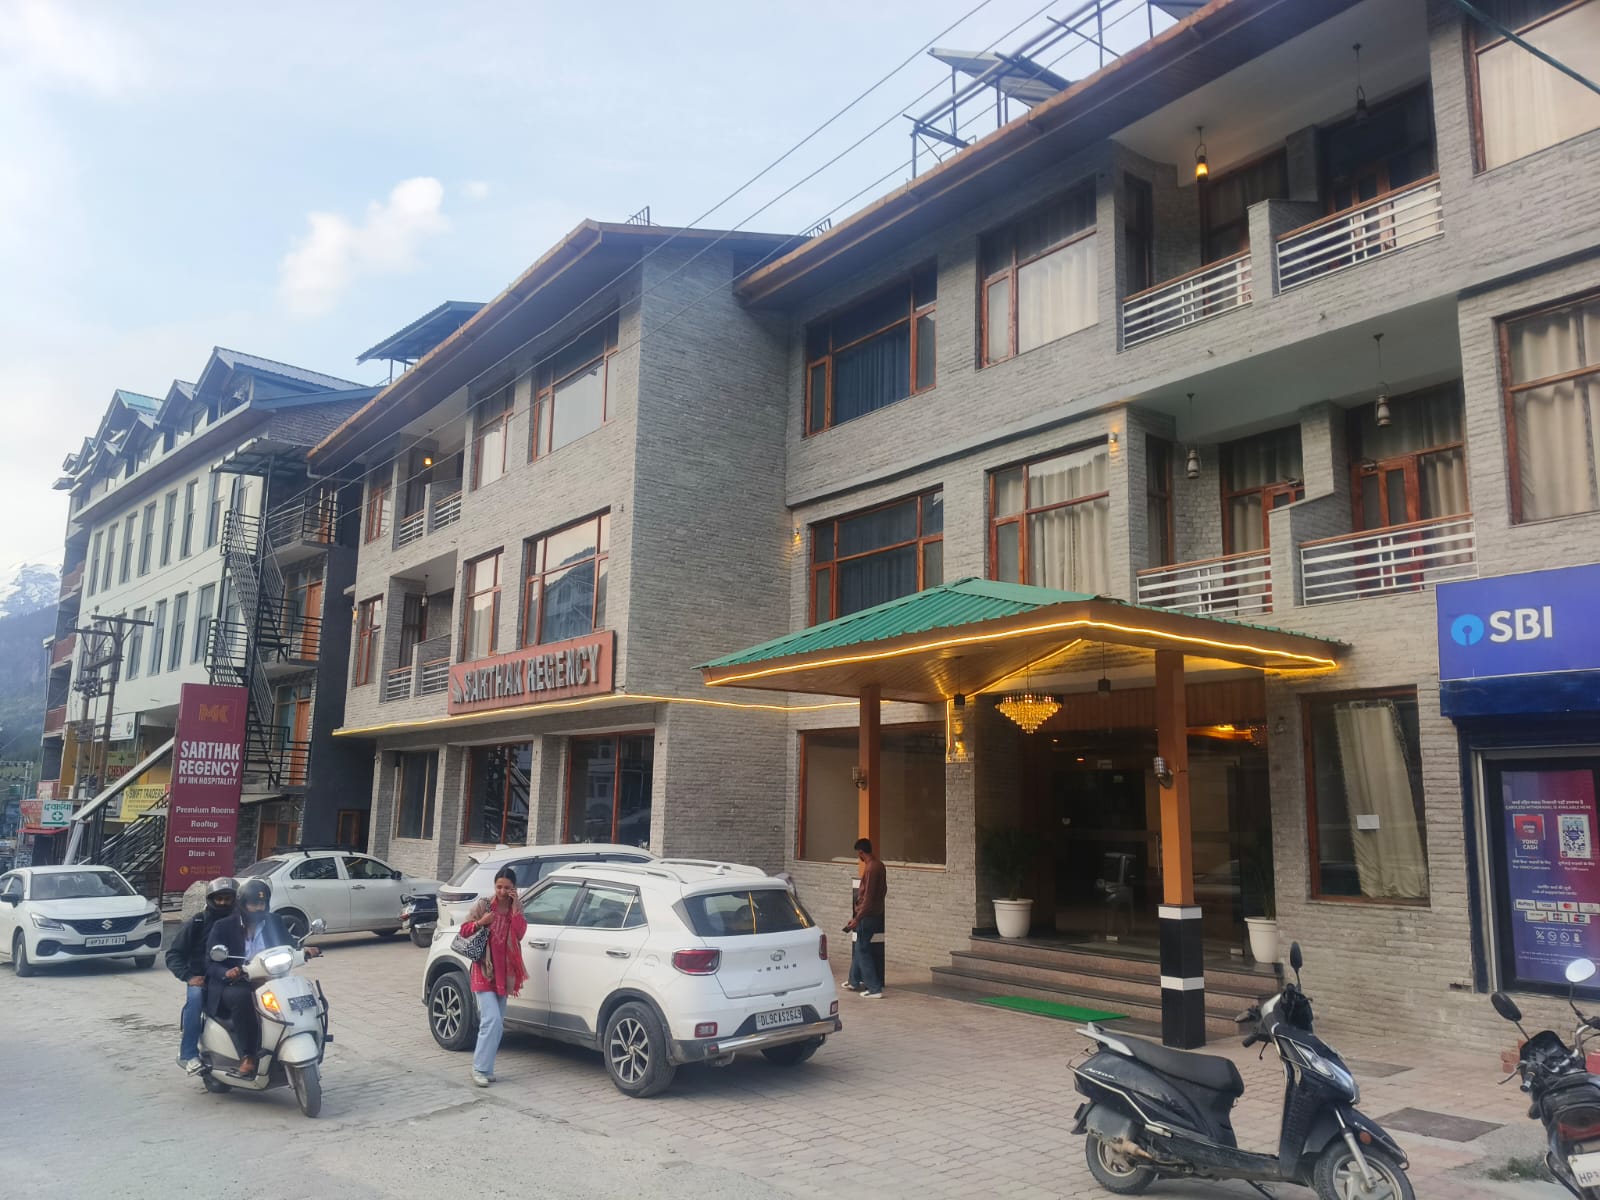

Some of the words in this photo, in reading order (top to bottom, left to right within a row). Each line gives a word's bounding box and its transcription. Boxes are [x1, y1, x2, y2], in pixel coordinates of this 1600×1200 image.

[1489, 605, 1553, 643] SBI
[464, 659, 525, 703] SARTHAK
[527, 643, 601, 692] REGENCY
[180, 740, 241, 760] SARTHAK
[178, 759, 240, 777] REGENCY
[178, 776, 188, 785] BY
[199, 777, 238, 785] HOSPITALITY
[175, 805, 209, 814] Premium
[210, 806, 236, 814] Rooms
[190, 820, 219, 829] Rooftop
[174, 835, 216, 843] Conference
[216, 835, 232, 843] Hall
[188, 849, 216, 857] Dine-in
